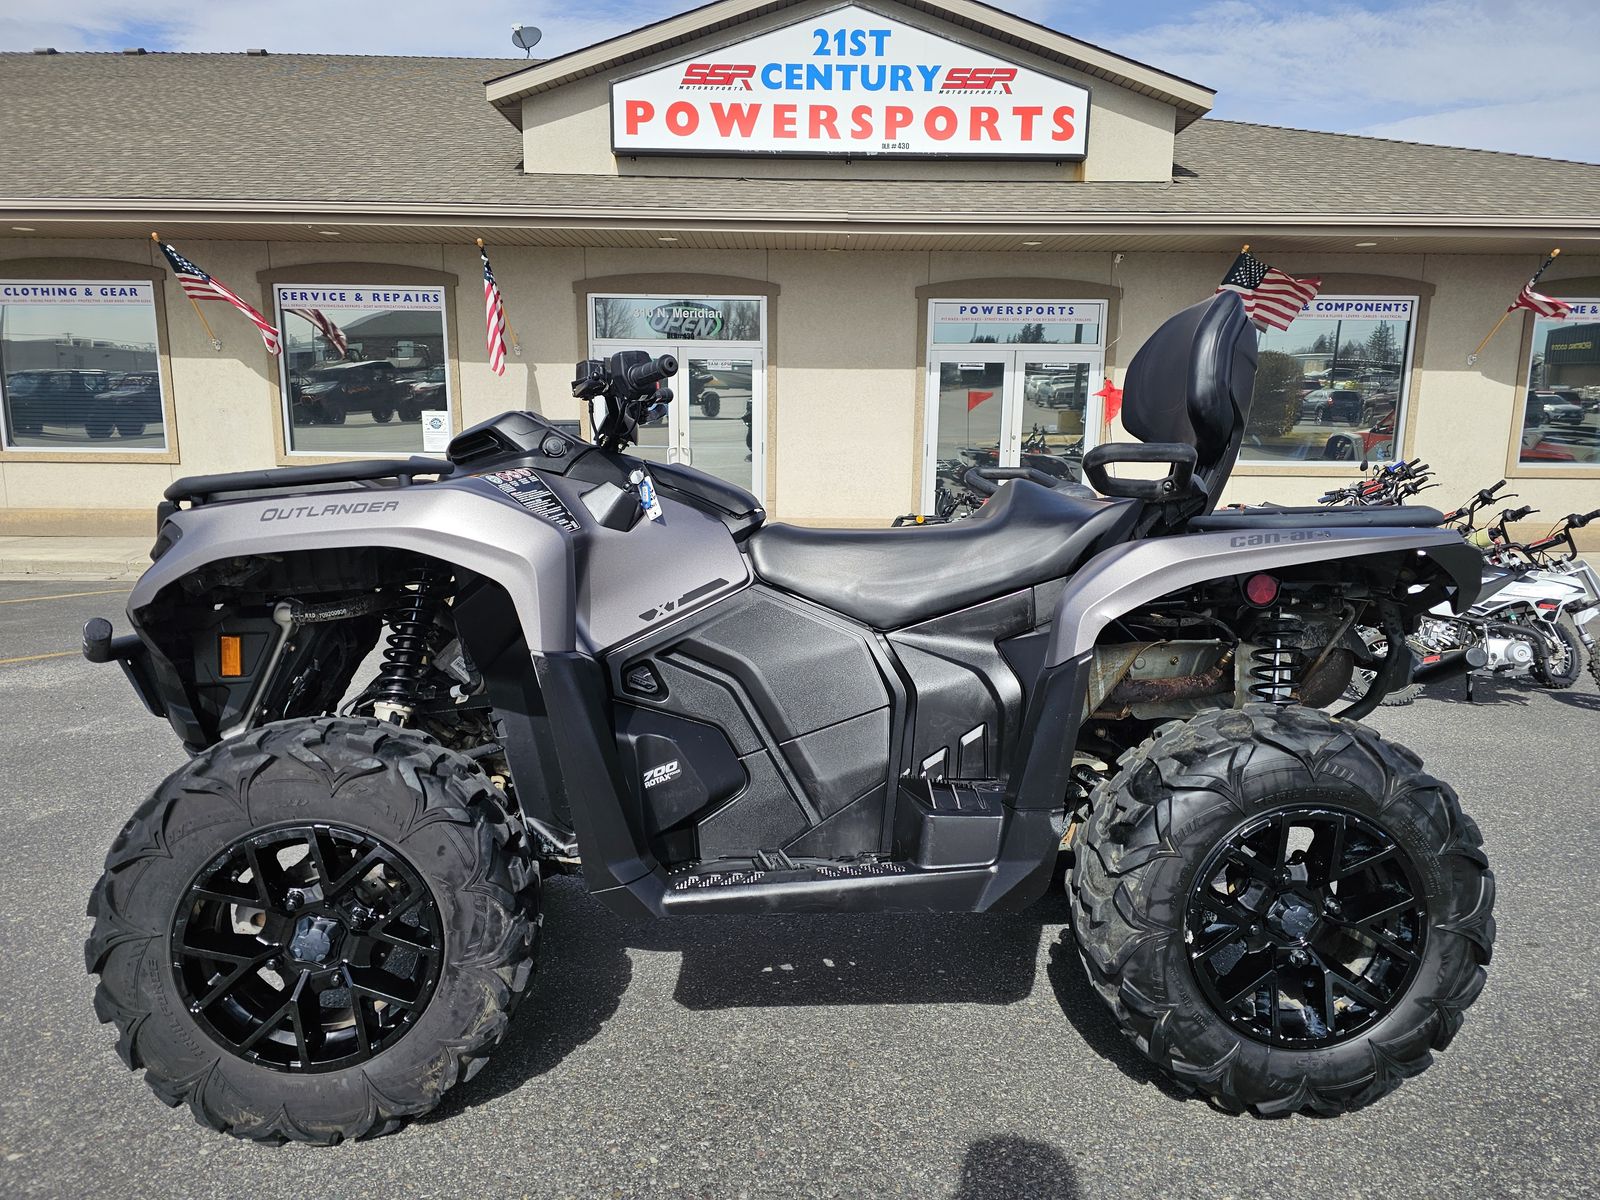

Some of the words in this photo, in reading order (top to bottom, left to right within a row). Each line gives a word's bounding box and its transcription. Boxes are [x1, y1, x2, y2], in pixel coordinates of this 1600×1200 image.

[813, 28, 892, 57] 21ST
[681, 63, 757, 91] SSR
[760, 63, 941, 92] CENTURY
[941, 68, 1018, 95] SSR
[625, 100, 1075, 141] POWERSPORTS
[3, 287, 77, 296] CLOTHING
[84, 287, 93, 296] &
[100, 287, 138, 296] GEAR
[281, 291, 346, 301] SERVICE
[354, 292, 363, 301] &
[372, 293, 439, 302] REPAIRS
[672, 307, 723, 318] Meridian
[959, 305, 1075, 315] POWERSPORTS
[1316, 302, 1408, 312] COMPONENTS
[1590, 305, 1598, 314] &
[259, 501, 399, 522] OUTLANDER
[643, 760, 678, 781] 700
[644, 773, 671, 789] ROTAX
